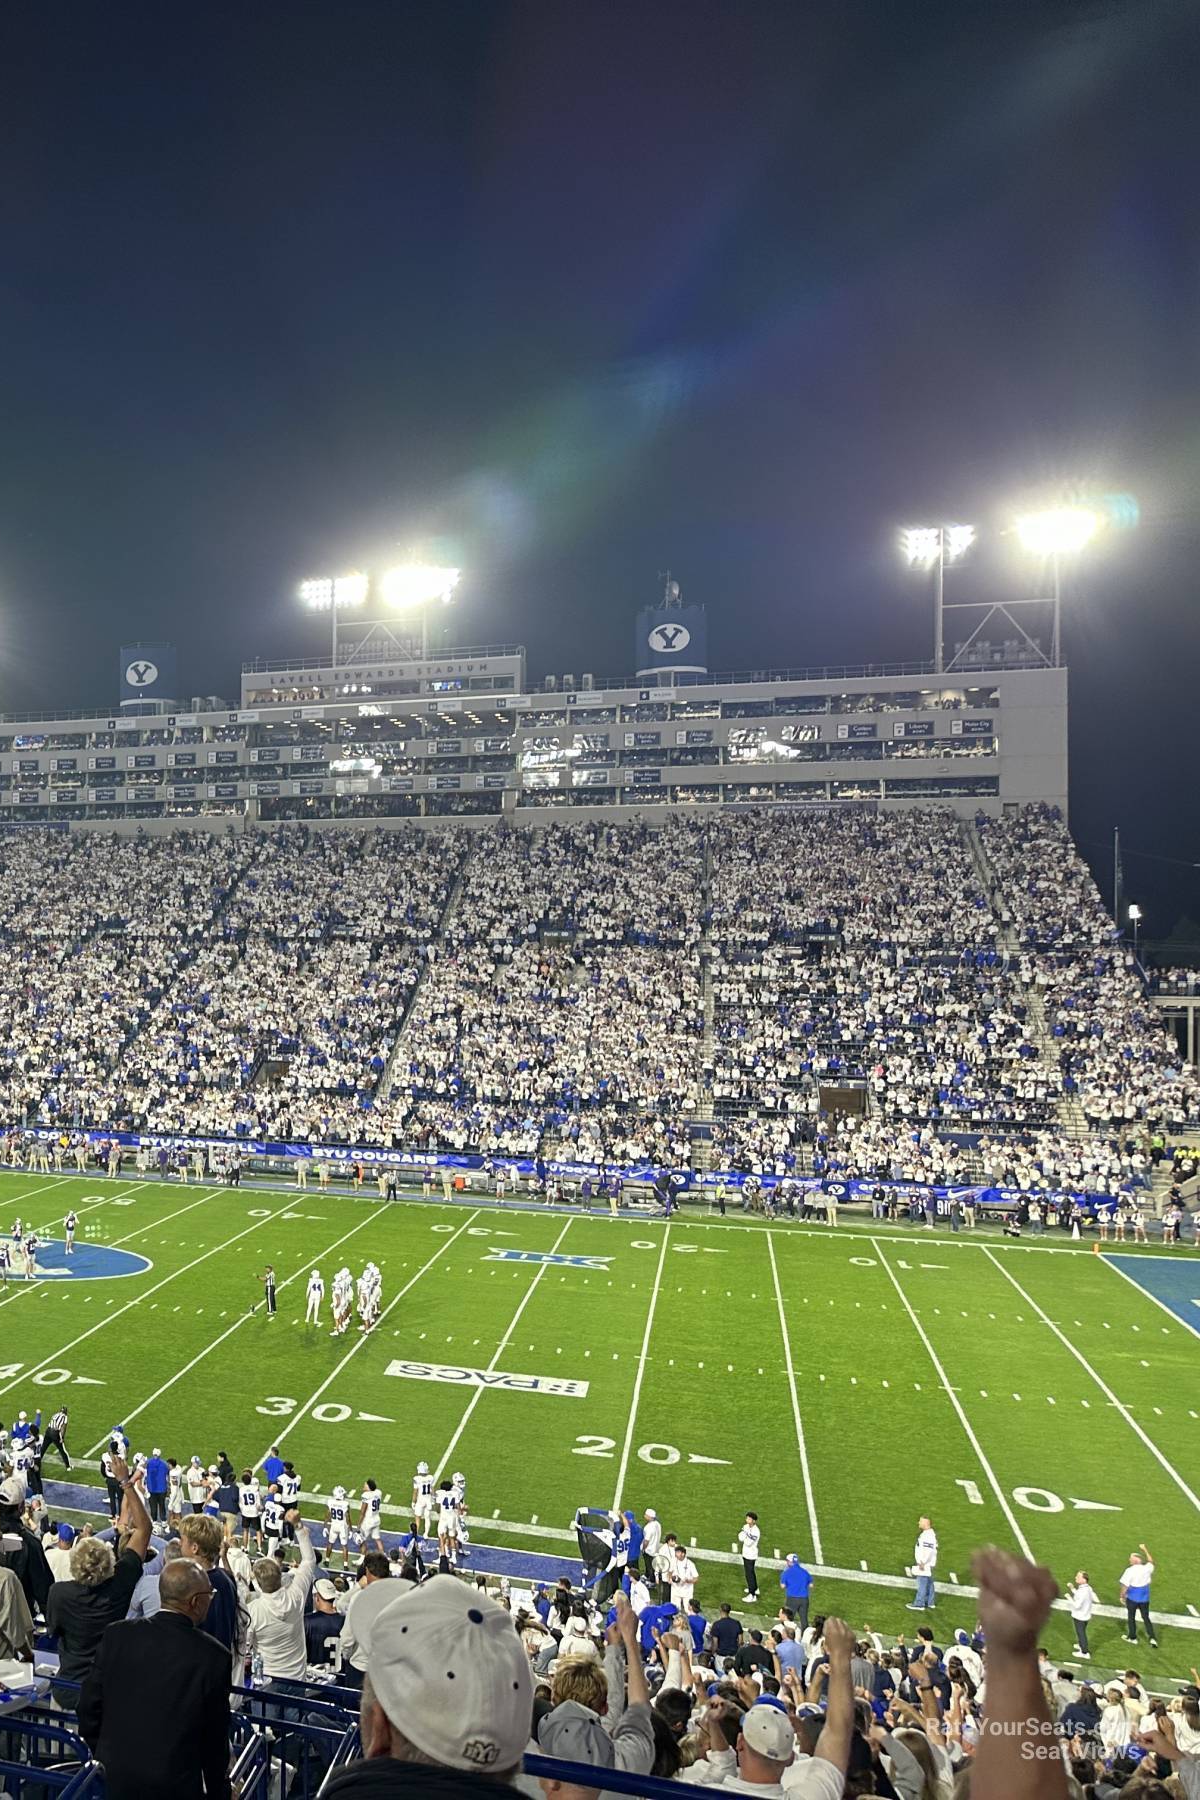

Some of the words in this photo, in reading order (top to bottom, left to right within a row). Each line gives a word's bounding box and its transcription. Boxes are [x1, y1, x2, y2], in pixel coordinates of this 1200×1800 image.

[270, 674, 323, 685] LAVELL
[334, 669, 404, 681] EDWARDS
[417, 663, 488, 675] STADIUM
[908, 722, 929, 730] Liberty
[139, 1137, 173, 1148] BYU
[311, 1147, 347, 1160] BYU
[350, 1149, 438, 1165] COUGARS
[81, 1195, 137, 1206] 50
[247, 1208, 304, 1220] 40
[430, 1224, 493, 1236] 30
[630, 1240, 698, 1253] 20
[849, 1256, 913, 1270] 10
[311, 1283, 322, 1292] 44
[398, 1363, 540, 1390] PACS
[255, 1396, 353, 1423] 30
[571, 1435, 681, 1465] 20
[286, 1484, 298, 1495] 71
[421, 1484, 431, 1496] 11
[955, 1479, 1065, 1513] 10
[243, 1493, 256, 1506] 19
[442, 1497, 456, 1510] 44
[330, 1508, 344, 1521] 89
[323, 1636, 342, 1672] 3
[463, 1740, 500, 1765] BYU
